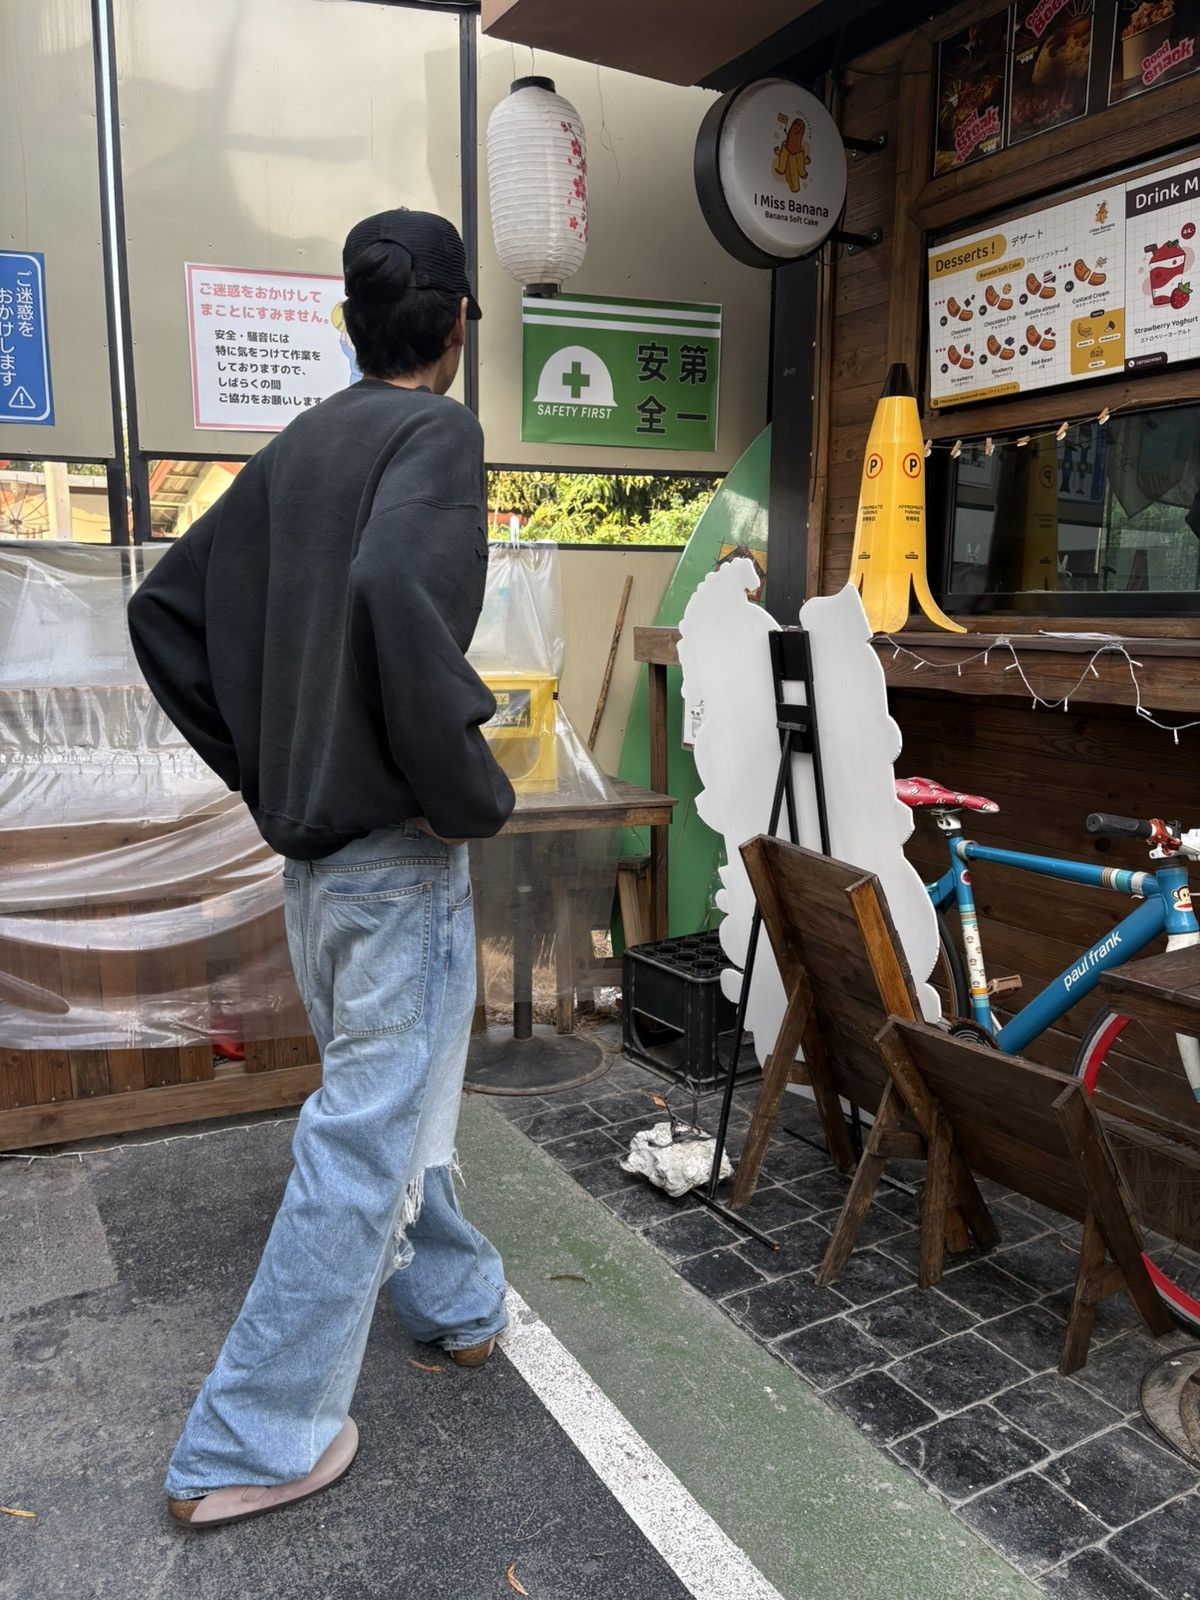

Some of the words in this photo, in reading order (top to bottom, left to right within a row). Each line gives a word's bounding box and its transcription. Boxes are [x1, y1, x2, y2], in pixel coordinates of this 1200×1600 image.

[1136, 182, 1180, 209] Drink
[754, 193, 758, 205] I
[761, 194, 786, 211] Miss
[788, 200, 829, 218] Banana
[765, 211, 788, 222] Banana
[789, 215, 803, 224] Soft
[804, 218, 819, 227] Cake
[1011, 229, 1044, 248] デザート
[979, 268, 997, 280] Banana
[200, 282, 322, 303] ご迷惑をおかけして
[1072, 294, 1092, 305] Custard
[1093, 290, 1110, 299] Cream
[16, 270, 35, 338] ご迷惑を
[200, 303, 329, 325] まことにすみません。
[984, 317, 1005, 328] Chocolate
[1006, 315, 1017, 323] Chip
[951, 327, 972, 336] Chocolate
[1133, 319, 1170, 335] Strawberry
[1171, 315, 1199, 330] Yoghurt
[215, 329, 290, 344] 安全・騒音には
[215, 345, 322, 361] 特に気をつけて作業を
[217, 361, 306, 376] しておりますので、
[992, 366, 1014, 375] Blueberry
[218, 377, 282, 390] しばらくの間
[676, 343, 710, 422] 第一
[951, 374, 974, 383] Strawberry
[635, 341, 669, 434] 安全
[537, 404, 578, 417] SAFETY
[581, 406, 612, 419] FIRST
[870, 459, 878, 473] P
[910, 458, 918, 473] P
[1063, 956, 1090, 992] paul
[1088, 930, 1123, 966] frank
